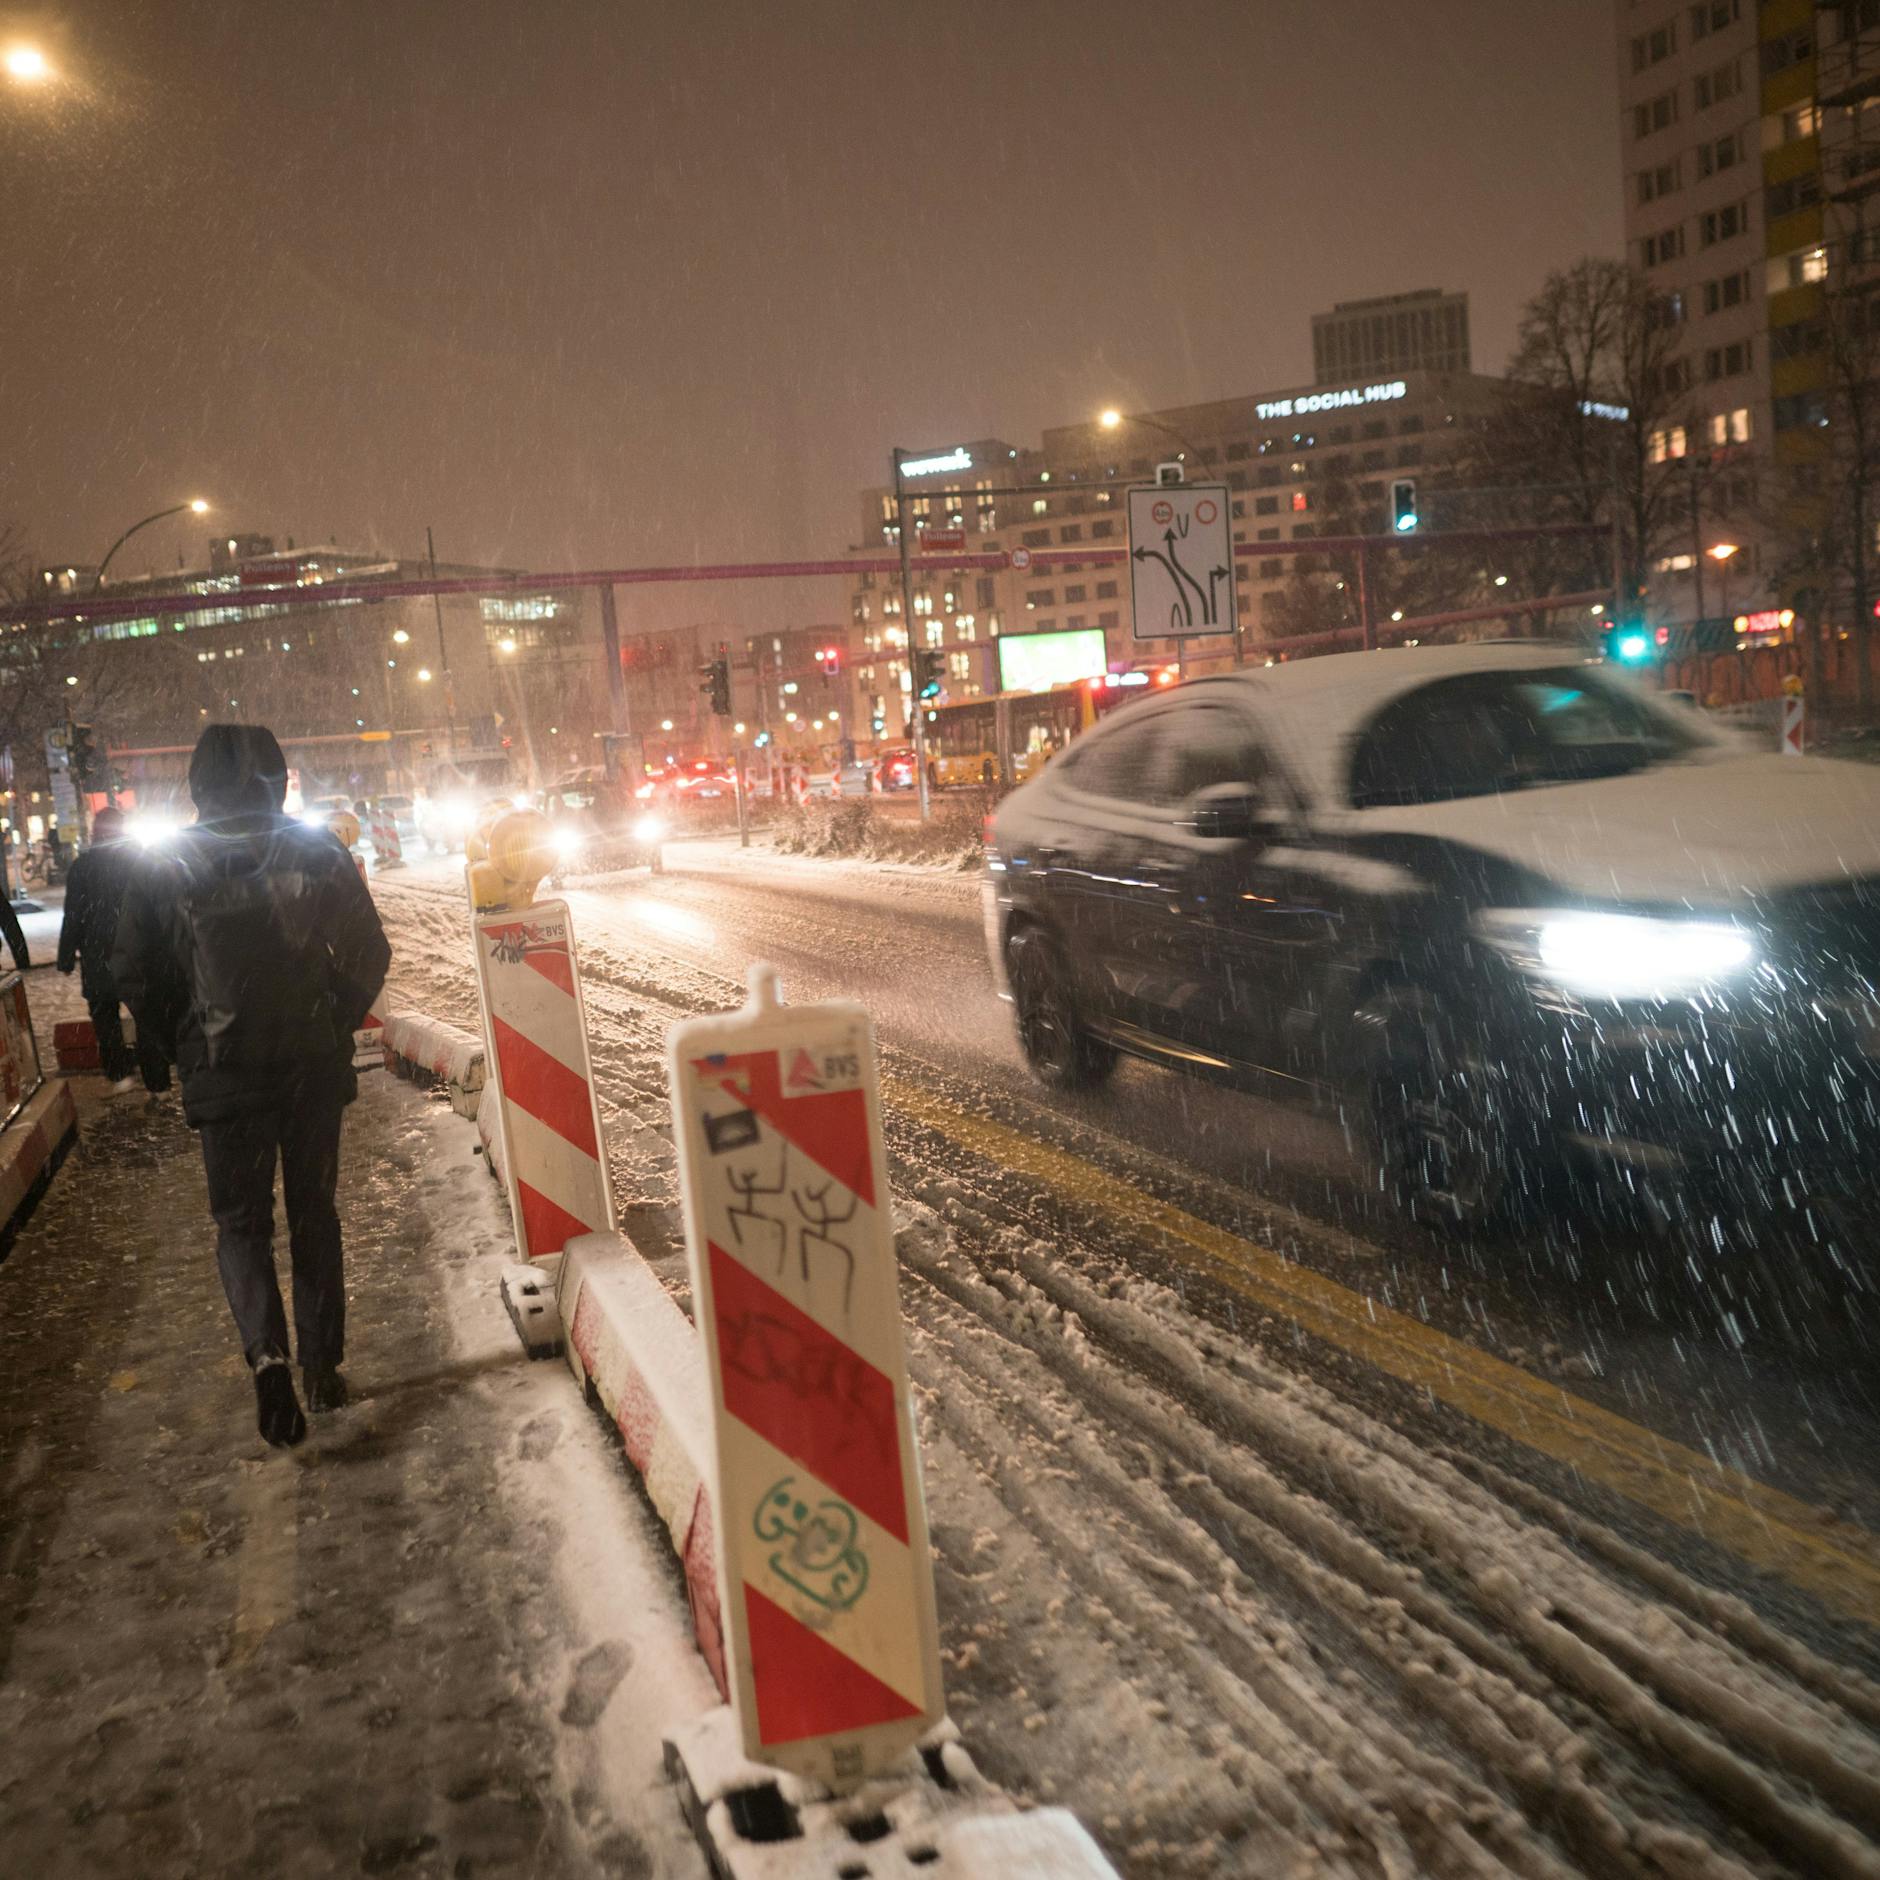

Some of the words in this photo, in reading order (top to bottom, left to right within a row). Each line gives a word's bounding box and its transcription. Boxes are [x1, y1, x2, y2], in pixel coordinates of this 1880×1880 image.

[1256, 400, 1292, 420] THE
[1294, 389, 1364, 414] SOCIAL
[1365, 381, 1406, 402] HUB
[545, 925, 564, 937] BVS
[824, 1053, 859, 1079] BVS
